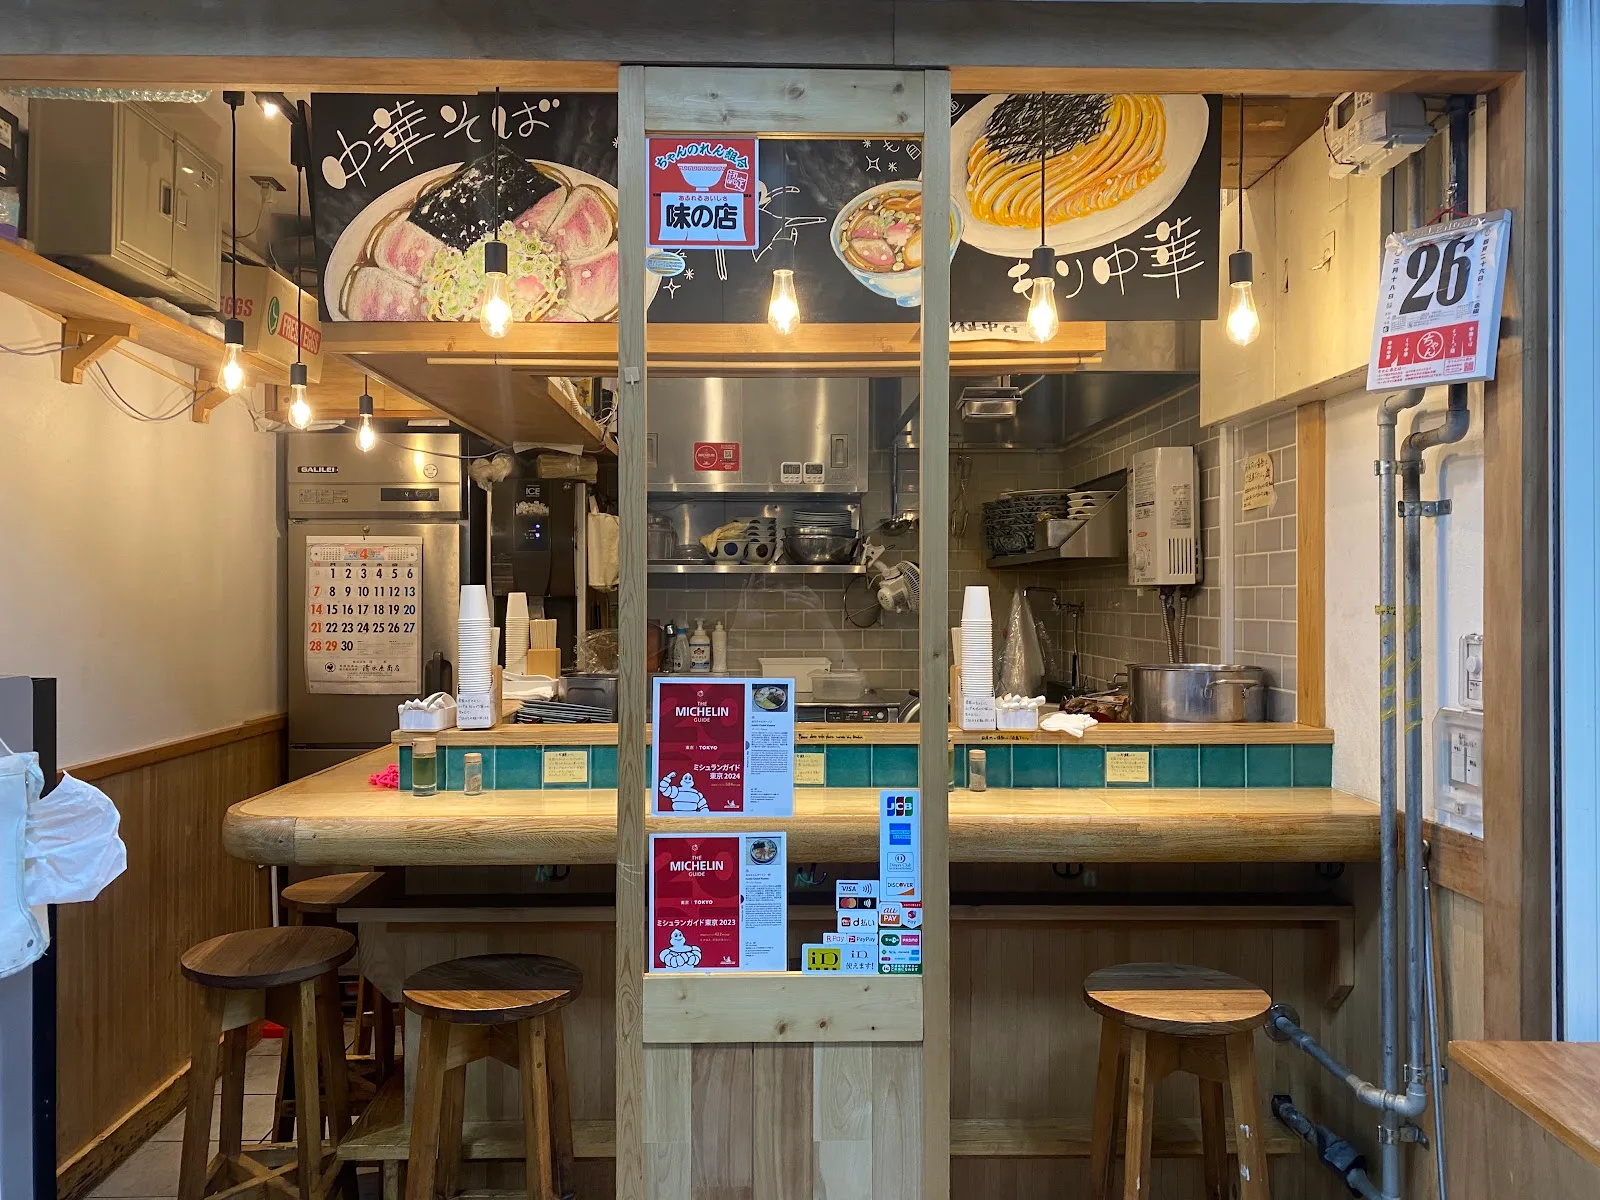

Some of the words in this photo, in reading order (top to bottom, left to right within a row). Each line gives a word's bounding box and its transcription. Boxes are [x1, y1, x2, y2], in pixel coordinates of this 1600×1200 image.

[321, 98, 560, 190] 中華そば
[655, 143, 749, 169] ちゃんのれん組合
[665, 203, 738, 230] 味の店
[1398, 236, 1475, 315] 26
[1423, 333, 1439, 357] ちゃん
[525, 487, 541, 495] ICE
[359, 548, 369, 560] 4
[330, 568, 335, 579] 1
[345, 568, 352, 579] 2
[360, 568, 367, 579] 3
[375, 568, 383, 579] 4
[391, 568, 398, 579] 5
[407, 568, 413, 579] 6
[314, 586, 320, 597] 7
[329, 586, 336, 597] 8
[344, 586, 351, 597] 9
[357, 586, 369, 597] 10
[374, 586, 385, 597] 11
[388, 586, 400, 597] 12
[404, 586, 416, 597] 13
[310, 604, 322, 615] 14
[326, 604, 338, 615] 15
[342, 604, 353, 615] 16
[357, 604, 369, 615] 17
[373, 604, 384, 615] 18
[388, 604, 400, 615] 19
[403, 604, 416, 615] 20
[310, 622, 322, 633] 21
[325, 622, 338, 633] 22
[341, 622, 354, 633] 23
[356, 622, 369, 633] 24
[372, 622, 385, 633] 25
[387, 622, 400, 633] 26
[403, 622, 415, 633] 27
[309, 640, 322, 651] 28
[325, 640, 337, 651] 29
[340, 640, 353, 651] 30
[675, 706, 729, 717] MICHELIN
[709, 772, 723, 780] 東京
[724, 772, 741, 780] 2024
[669, 860, 724, 871] MICHELIN
[656, 919, 718, 927] ミシュランガイド東京
[853, 917, 875, 927] d払い
[811, 951, 839, 966] iD
[851, 950, 868, 959] iD
